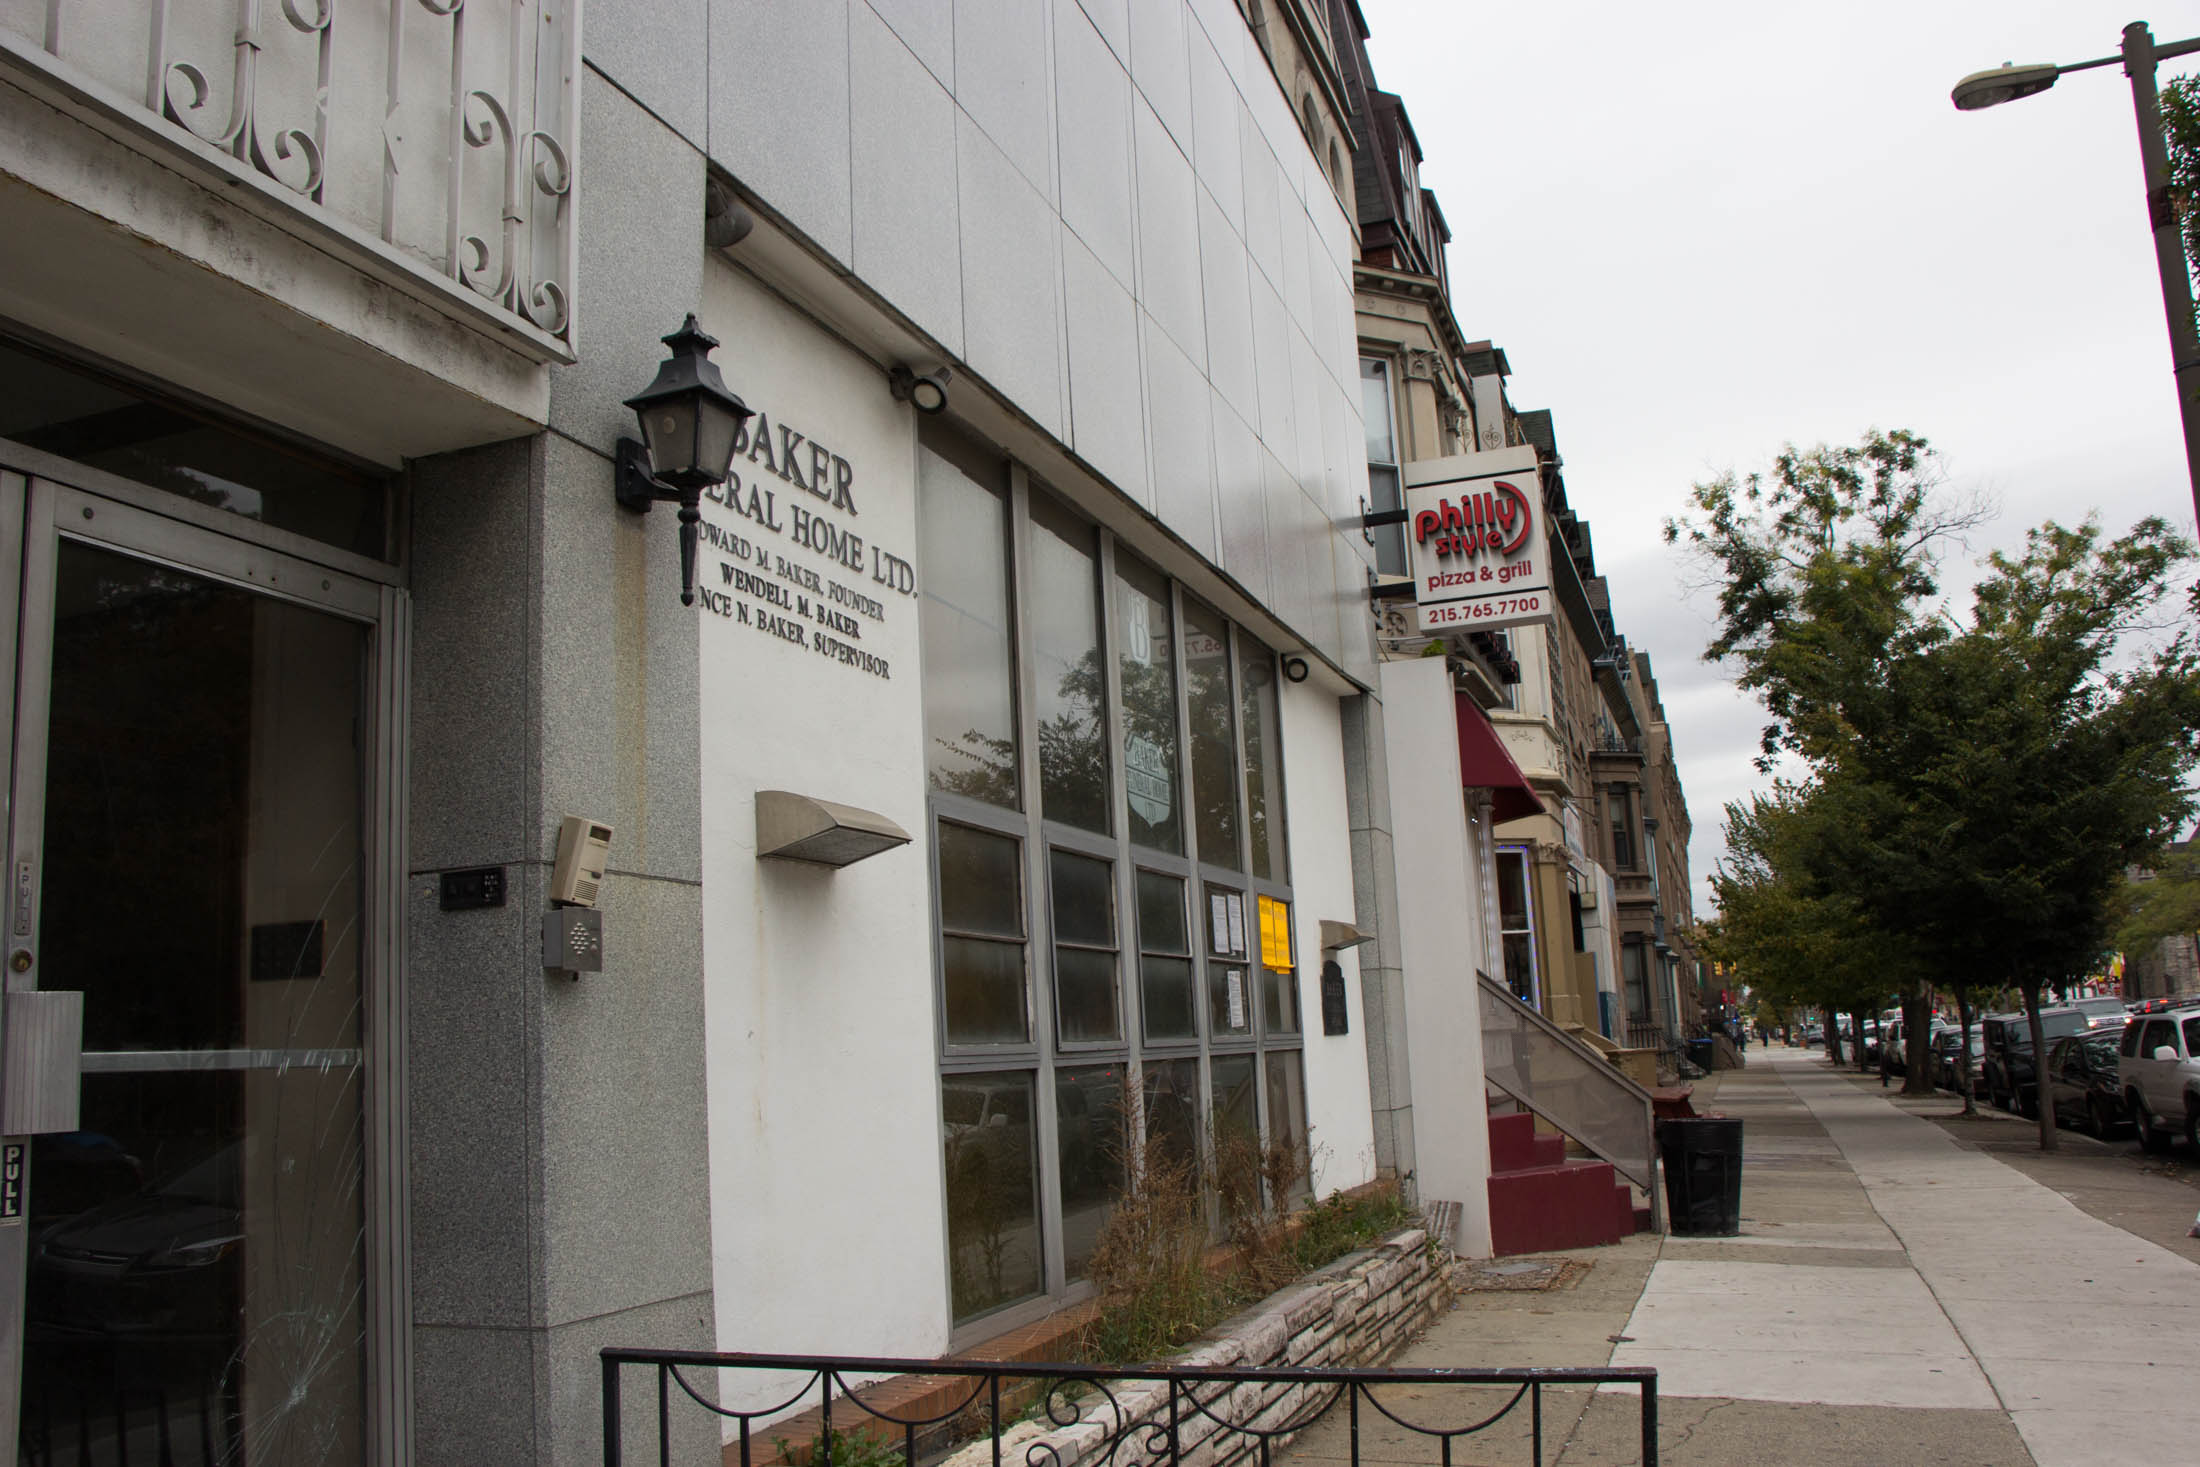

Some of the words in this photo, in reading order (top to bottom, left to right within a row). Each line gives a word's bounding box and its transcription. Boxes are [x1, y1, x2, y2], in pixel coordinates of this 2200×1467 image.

[1415, 491, 1516, 543] philly
[1436, 524, 1503, 557] style
[790, 503, 865, 573] HOME
[872, 545, 918, 600] LTD.
[1428, 571, 1475, 592] pizza
[1480, 566, 1493, 582] &
[1498, 560, 1533, 583] grill
[720, 562, 792, 611] WENDELL
[798, 595, 813, 619] M.
[817, 604, 861, 640] BAKER
[776, 556, 824, 596] BAKER,
[828, 579, 884, 623] FOUNDER
[1429, 598, 1539, 623] 215.765.7700
[737, 601, 753, 626] N.
[757, 608, 809, 649] BAKER,
[813, 632, 890, 680] SUPERVISOR
[4, 1146, 20, 1216] PULL
